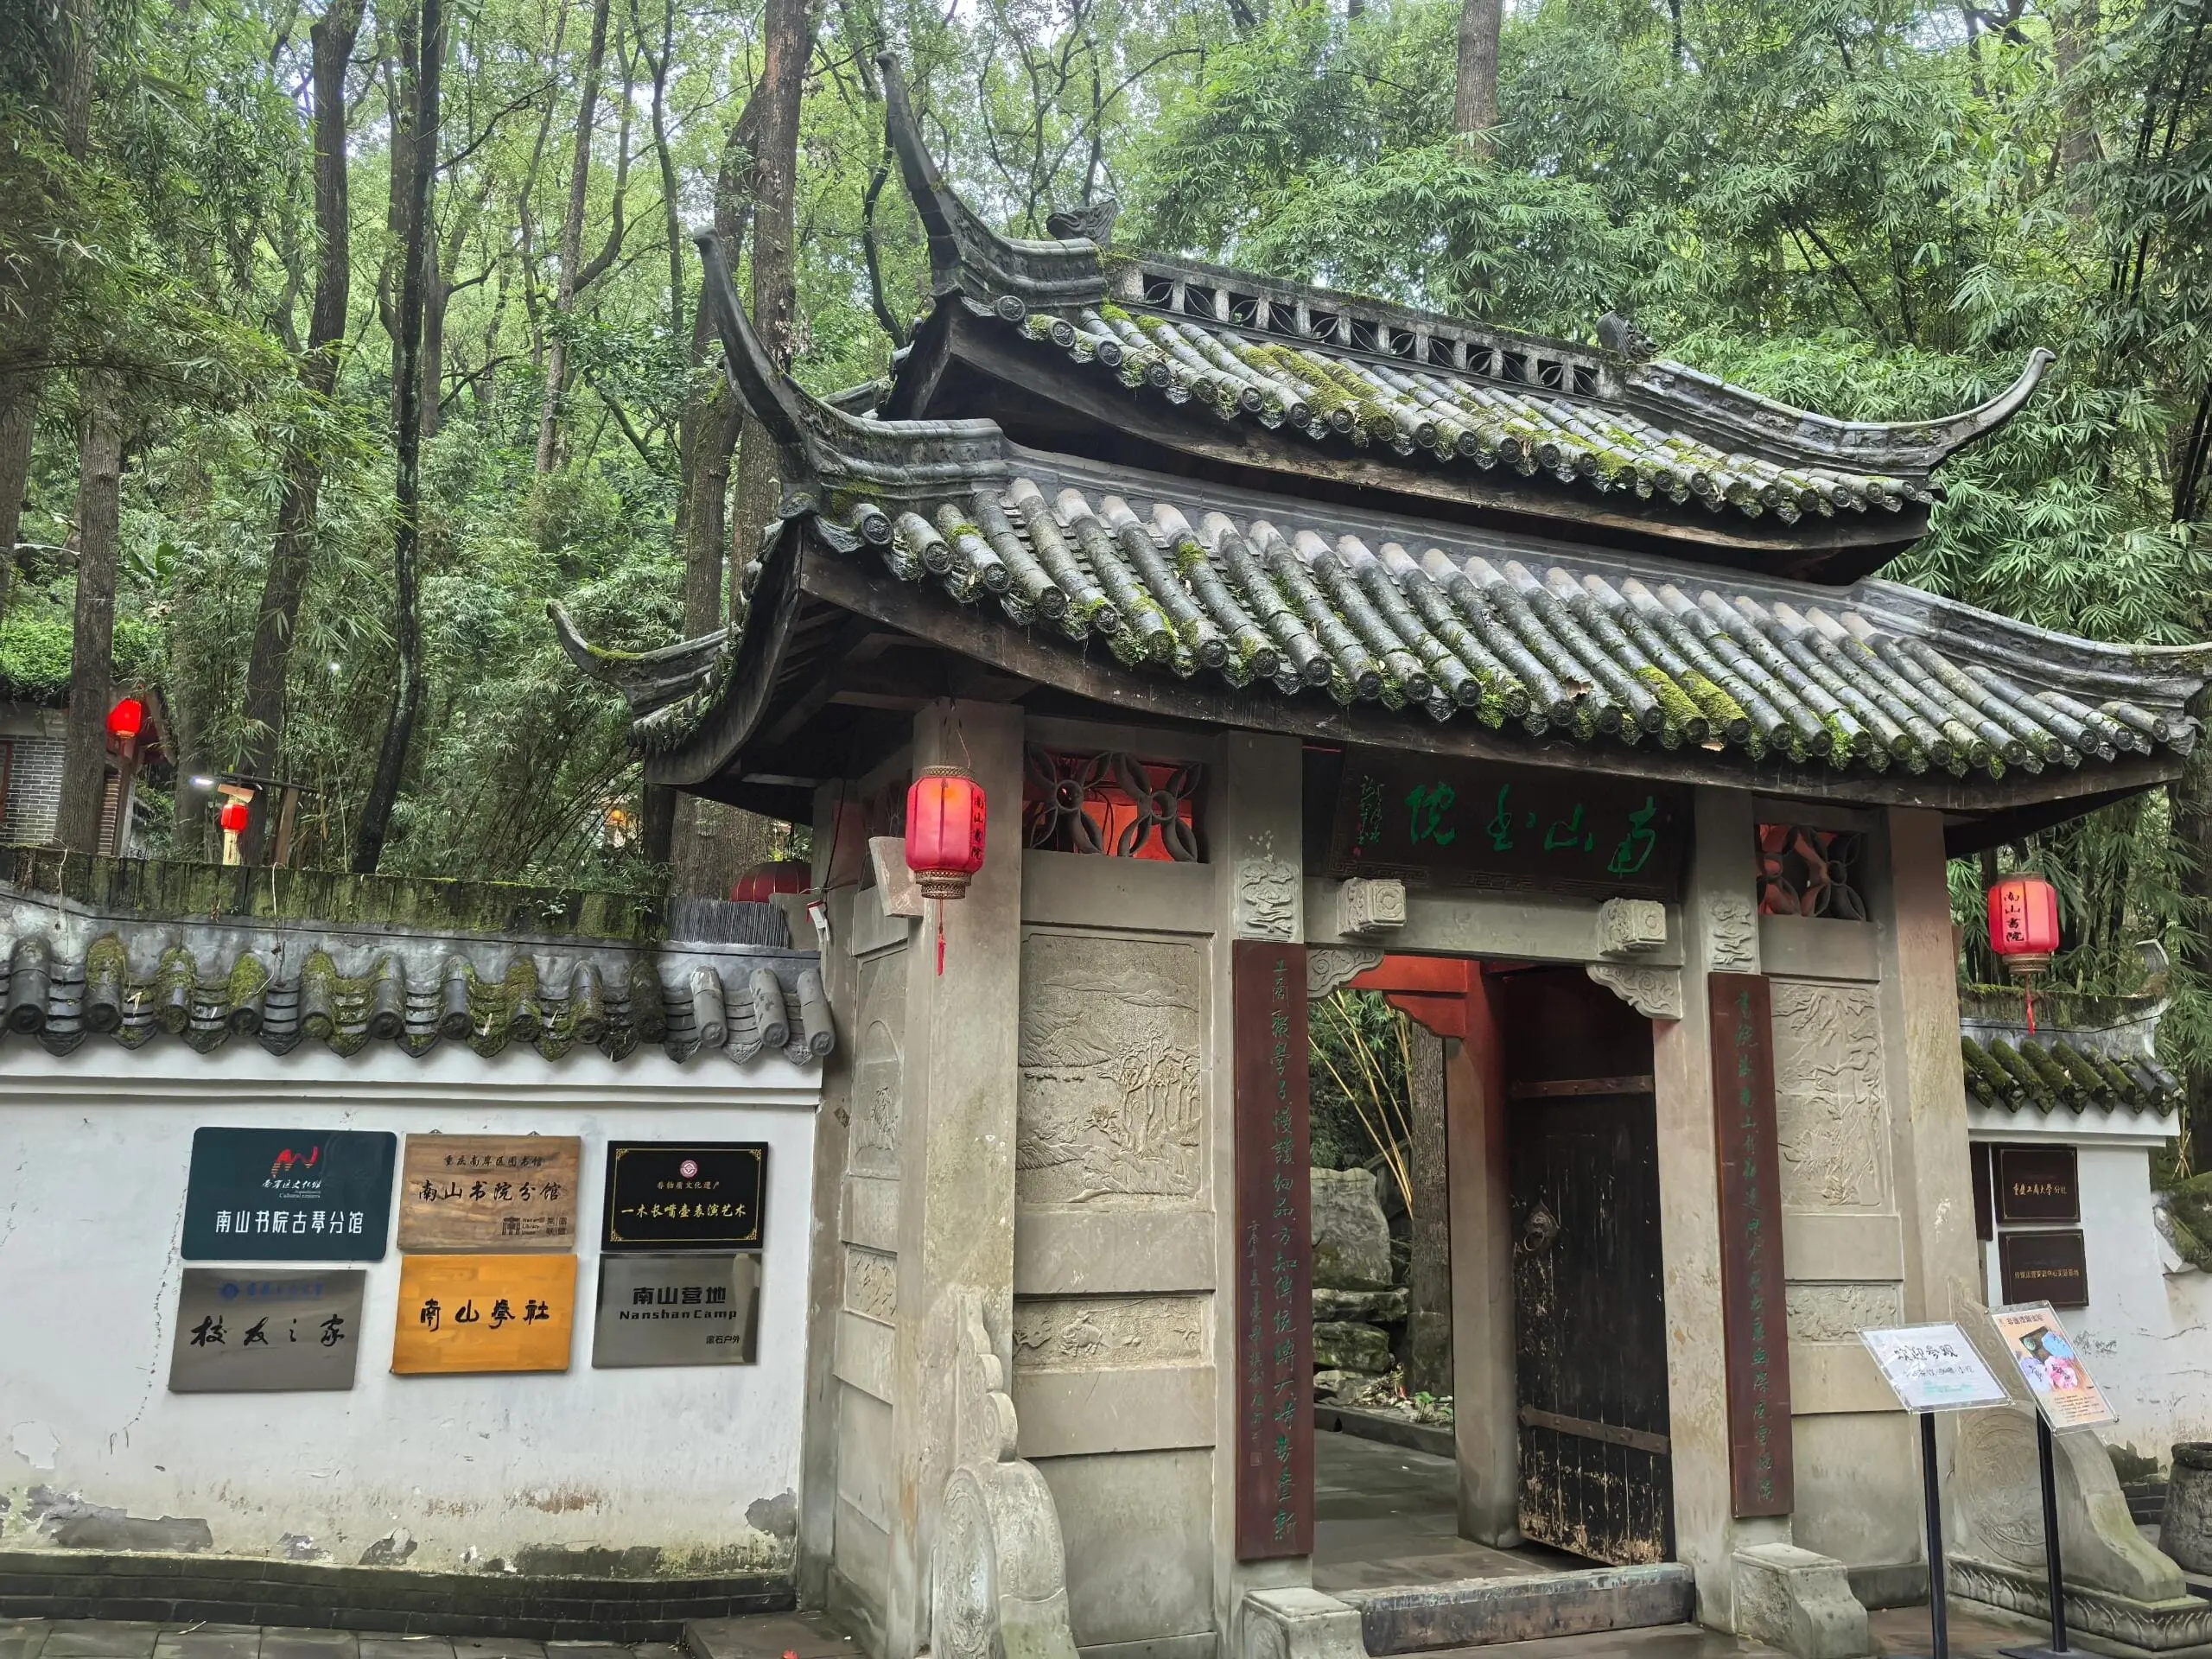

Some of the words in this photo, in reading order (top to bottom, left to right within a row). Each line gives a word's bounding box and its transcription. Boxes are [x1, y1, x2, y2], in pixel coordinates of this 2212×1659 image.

[419, 1179, 562, 1202] 南山书院分馆
[215, 1210, 364, 1234] 南山书院古琴分馆
[632, 1287, 727, 1305] 南山营地
[620, 1309, 690, 1320] Nanshan
[694, 1309, 737, 1320] Camp
[190, 1313, 345, 1347] 校友之家
